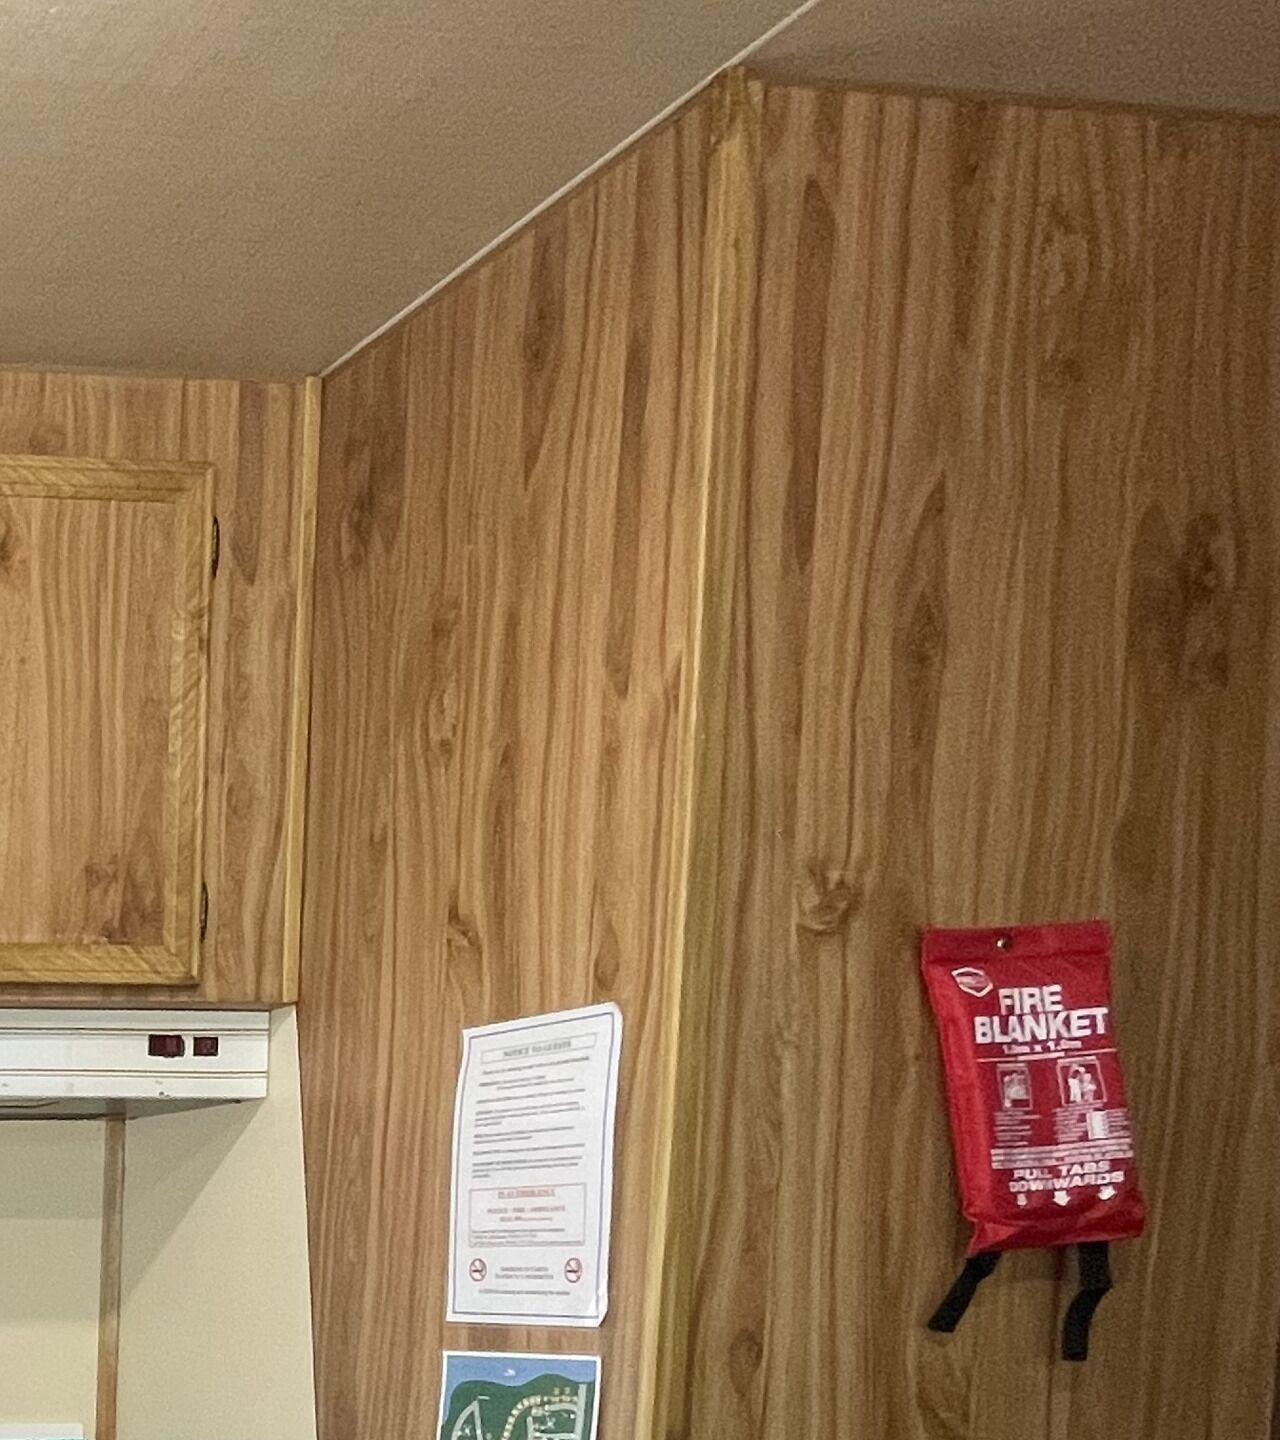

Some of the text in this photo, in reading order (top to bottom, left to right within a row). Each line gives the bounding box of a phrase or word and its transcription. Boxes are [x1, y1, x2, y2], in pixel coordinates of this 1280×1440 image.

[998, 983, 1064, 1015] FIRE
[974, 1006, 1109, 1044] BLANKET
[1007, 1170, 1125, 1193] DOWNWARDS
[1012, 1159, 1111, 1180] PULL TABS
